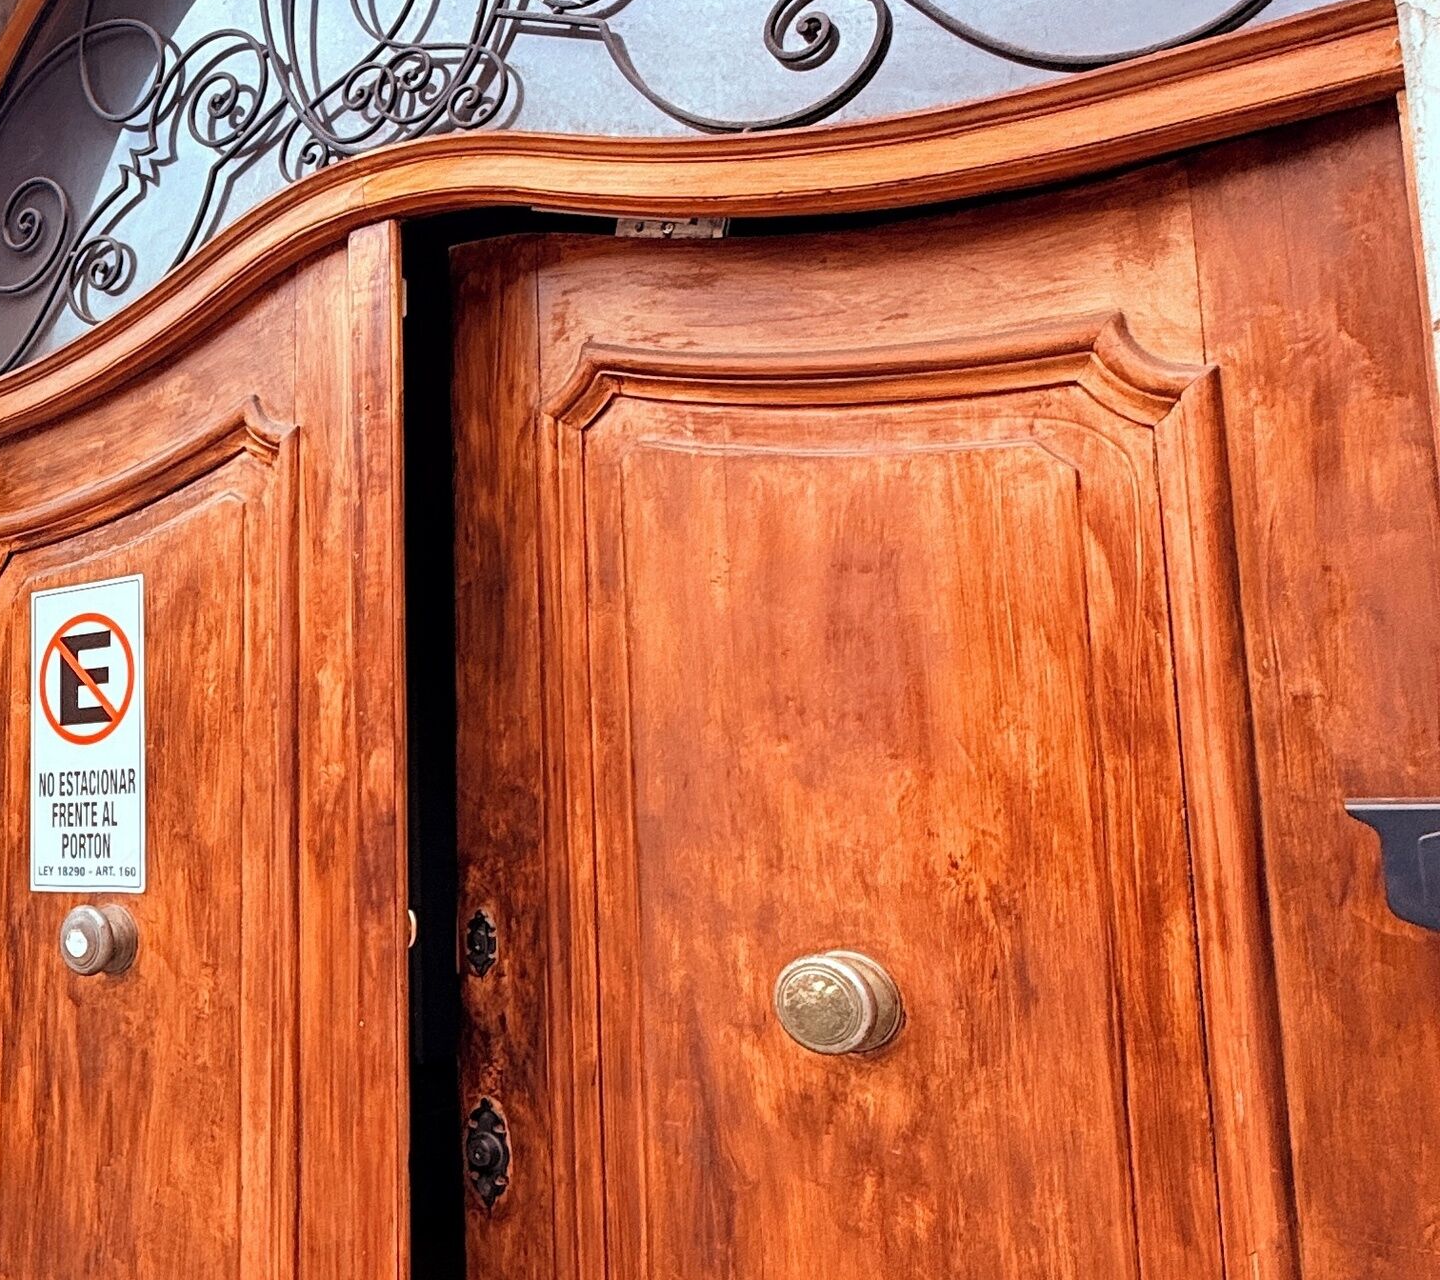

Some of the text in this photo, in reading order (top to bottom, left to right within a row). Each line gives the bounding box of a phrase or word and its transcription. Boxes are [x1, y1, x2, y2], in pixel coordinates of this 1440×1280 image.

[59, 629, 113, 726] E
[38, 768, 136, 797] NO ESTACIONAR
[51, 800, 118, 828] FRENTE AL
[61, 832, 111, 859] PORTON
[38, 865, 54, 876] LEY
[95, 865, 116, 877] ART.
[118, 866, 137, 877] 160
